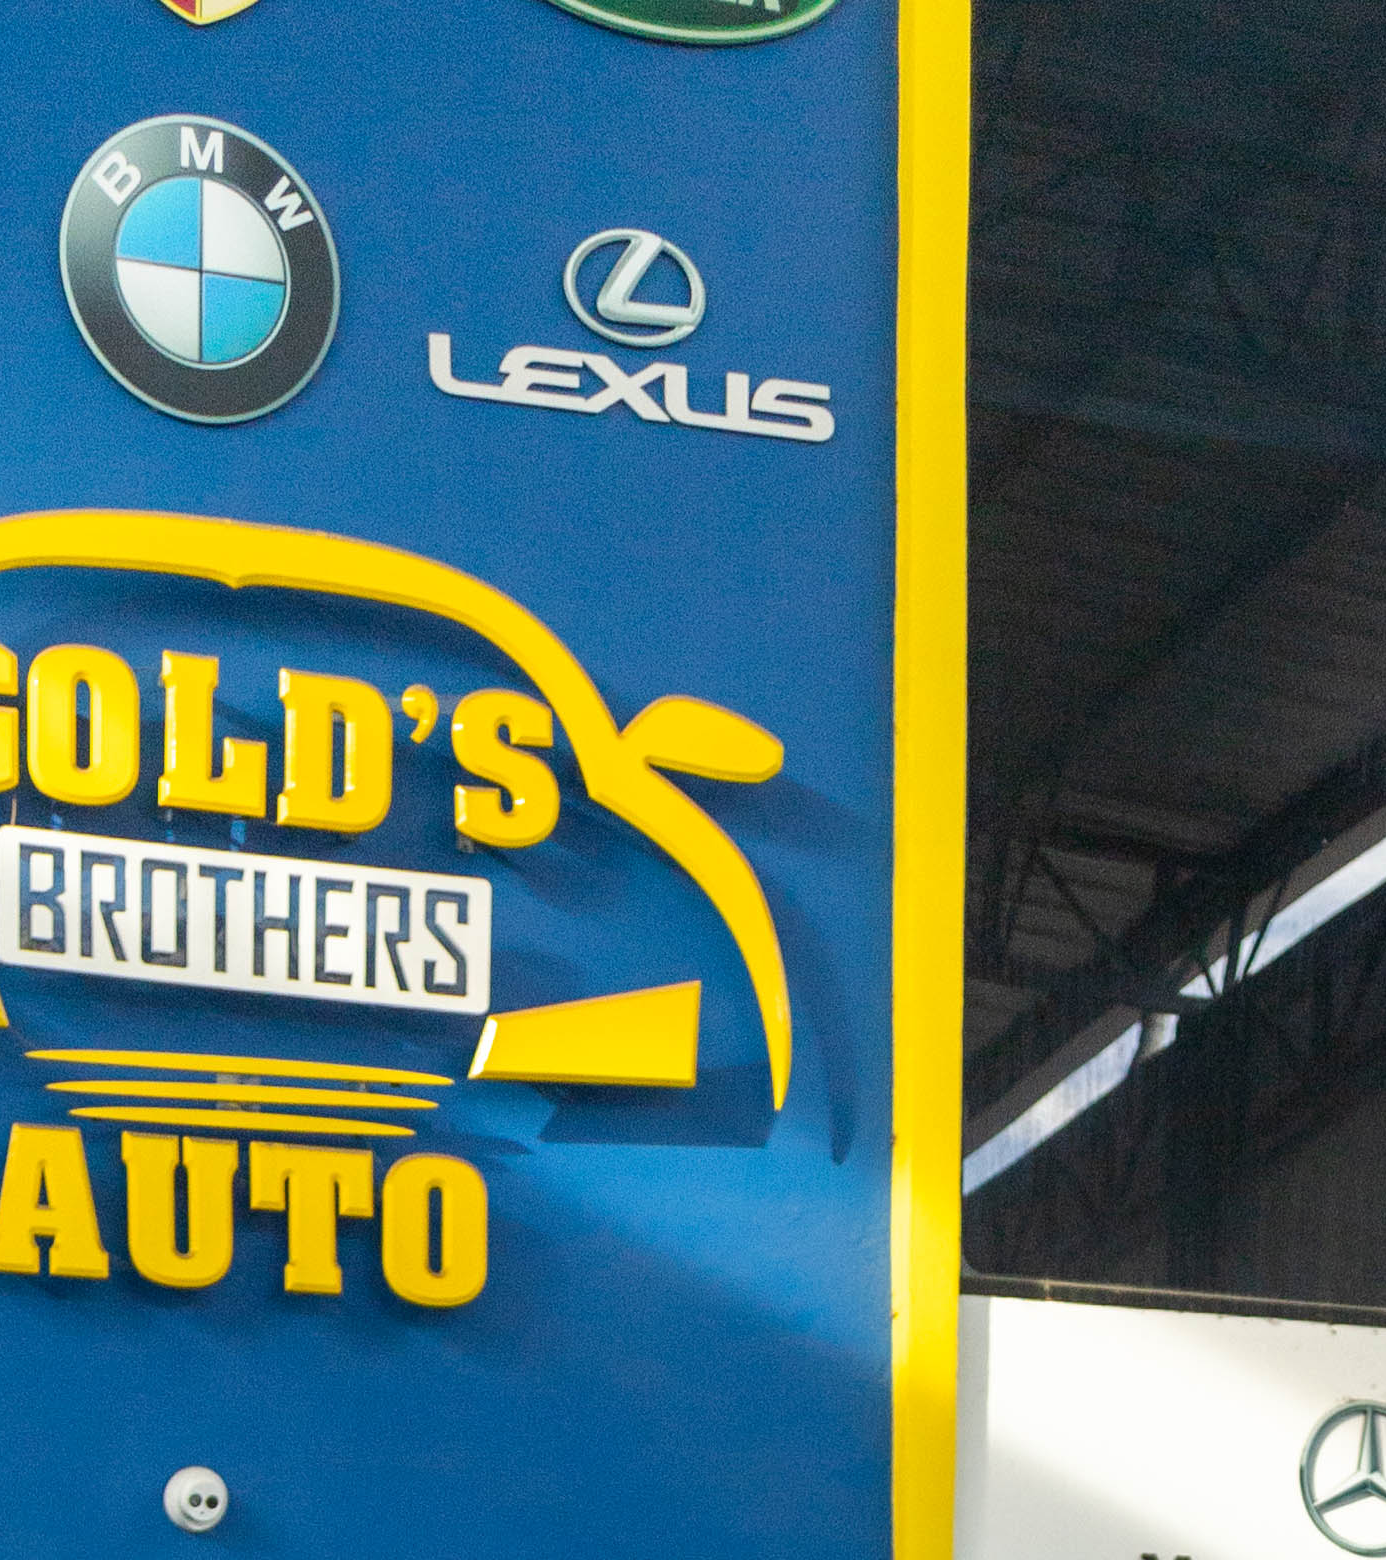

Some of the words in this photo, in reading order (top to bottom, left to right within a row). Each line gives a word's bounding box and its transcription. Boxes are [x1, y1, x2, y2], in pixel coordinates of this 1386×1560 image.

[93, 127, 314, 232] BMW
[427, 332, 836, 444] LEXUS
[17, 843, 470, 998] BROTHERS
